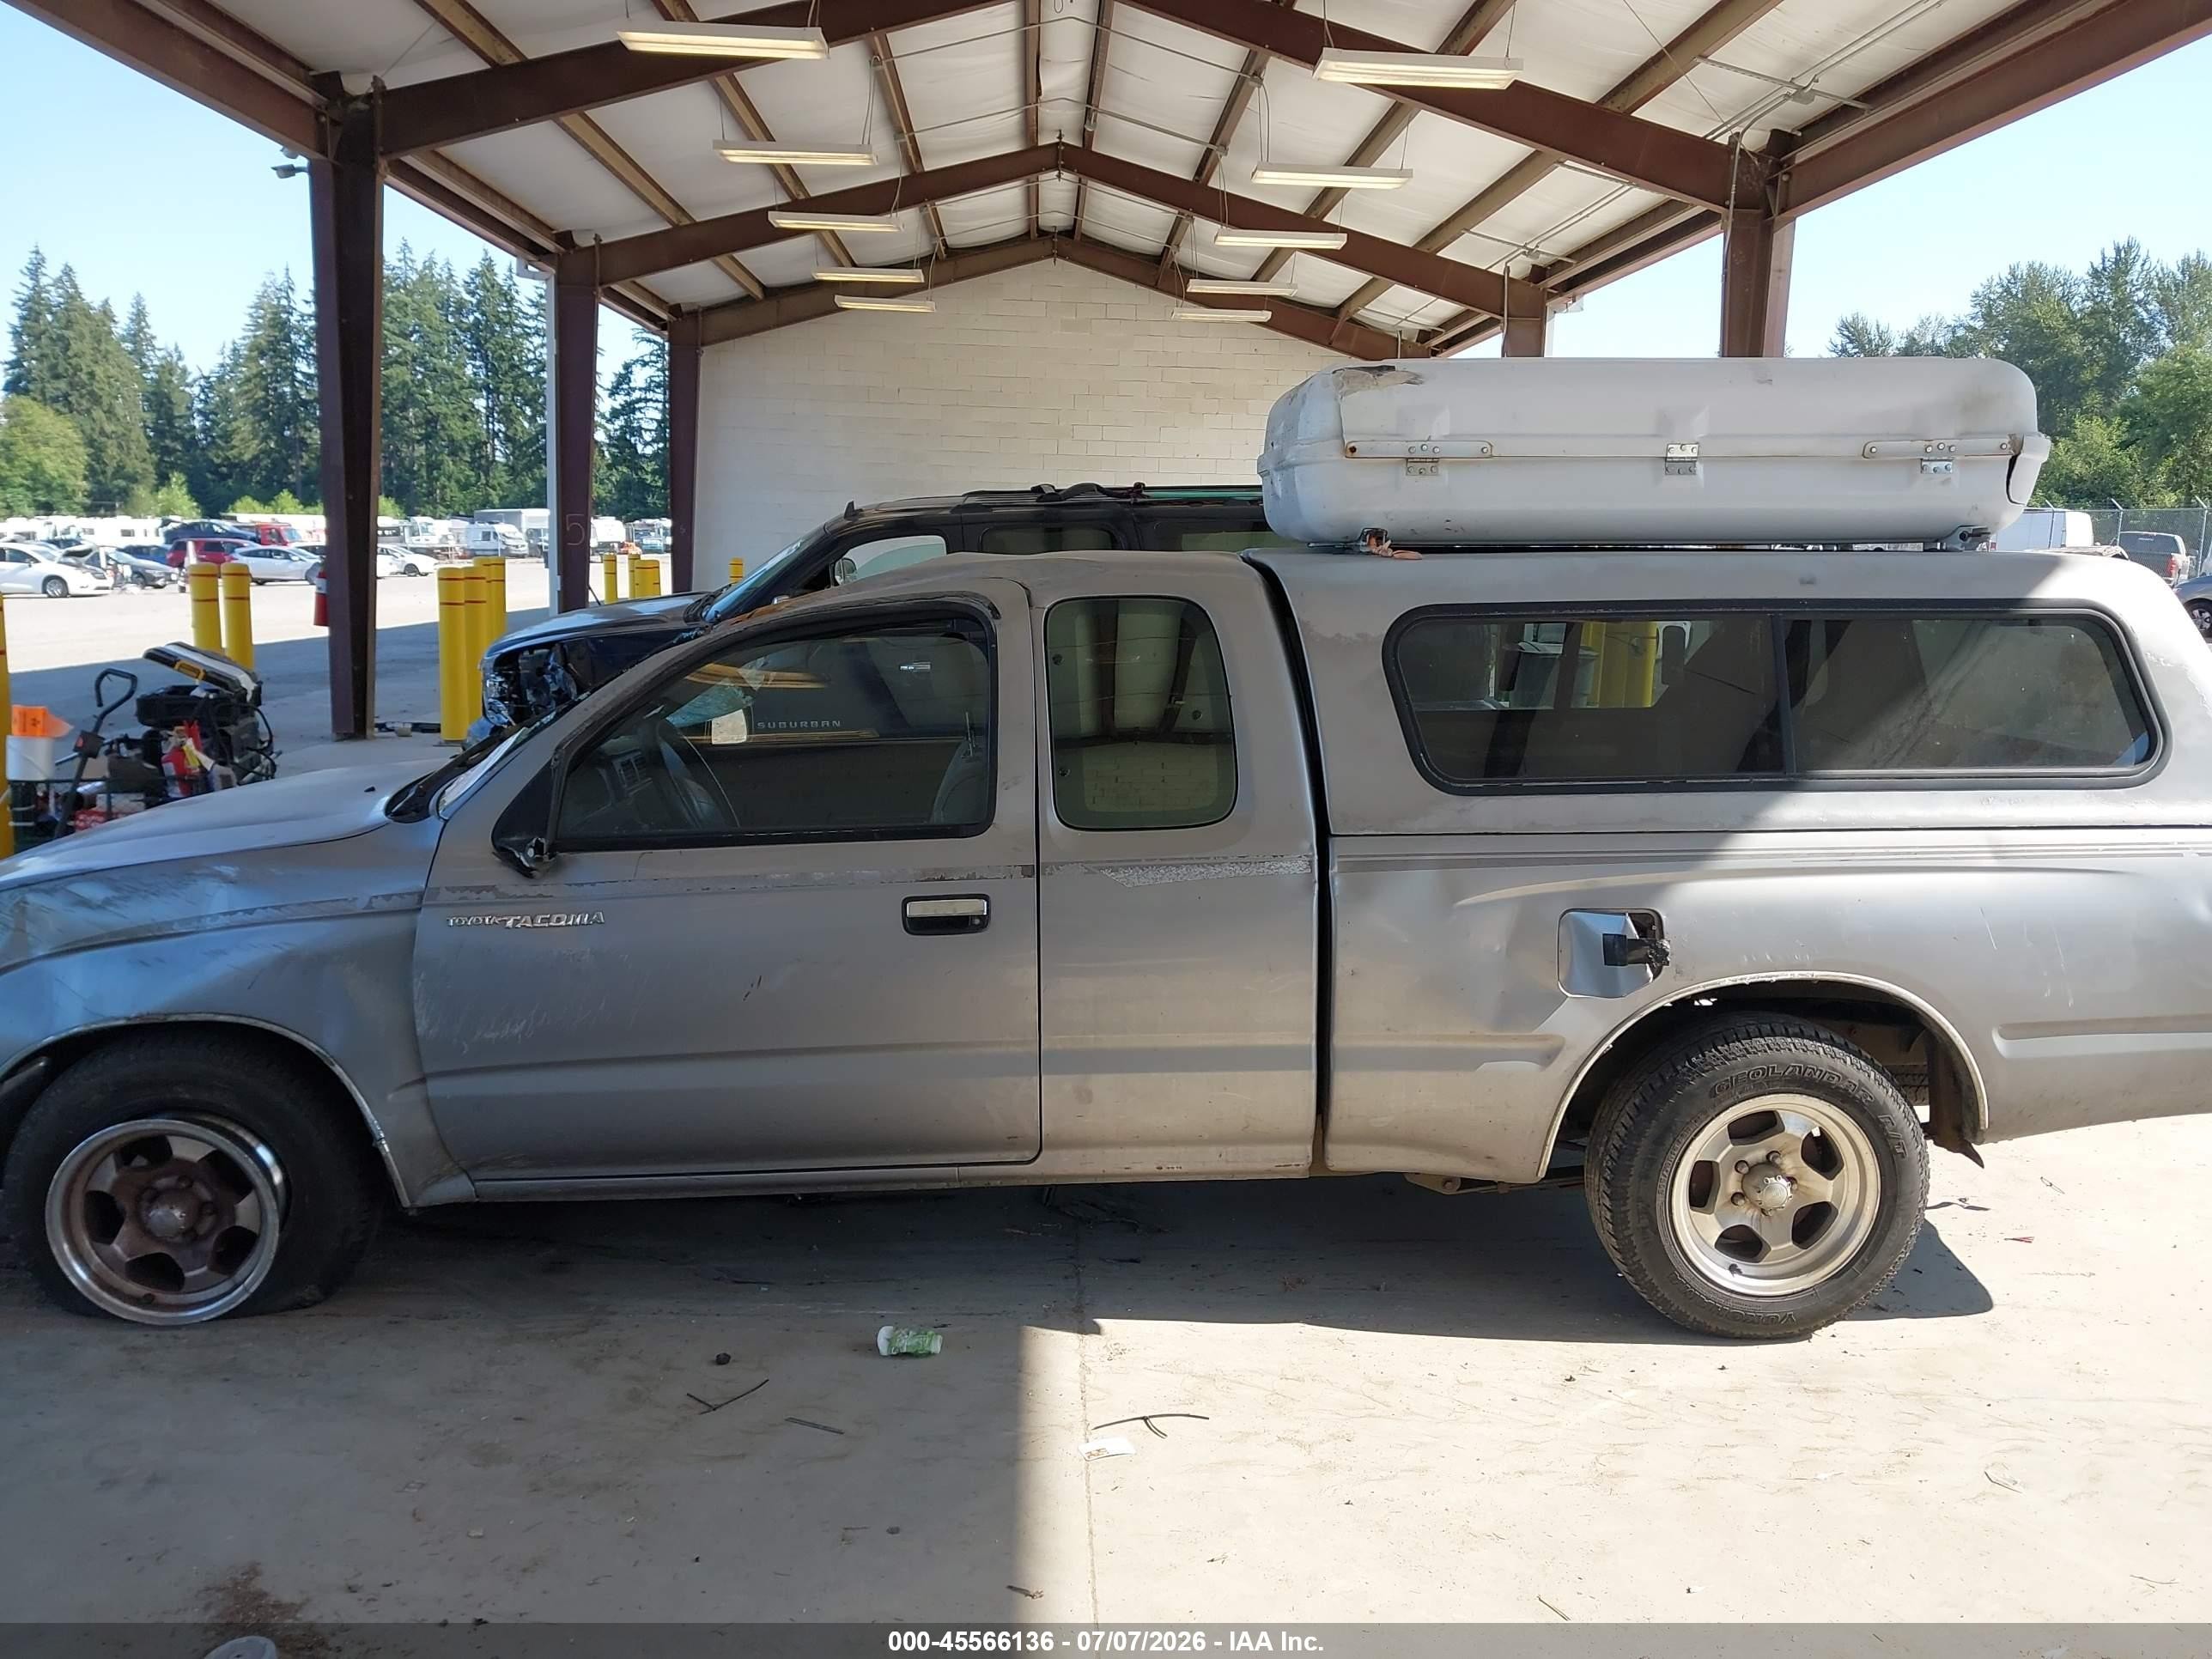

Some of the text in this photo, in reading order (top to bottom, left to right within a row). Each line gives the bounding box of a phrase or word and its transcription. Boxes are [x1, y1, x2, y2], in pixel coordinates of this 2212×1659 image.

[566, 514, 586, 546] 5
[757, 720, 842, 729] SUBURBAN
[447, 910, 605, 929] TOYOTA TACOMA
[1712, 1063, 1875, 1104] GEOLANDAR
